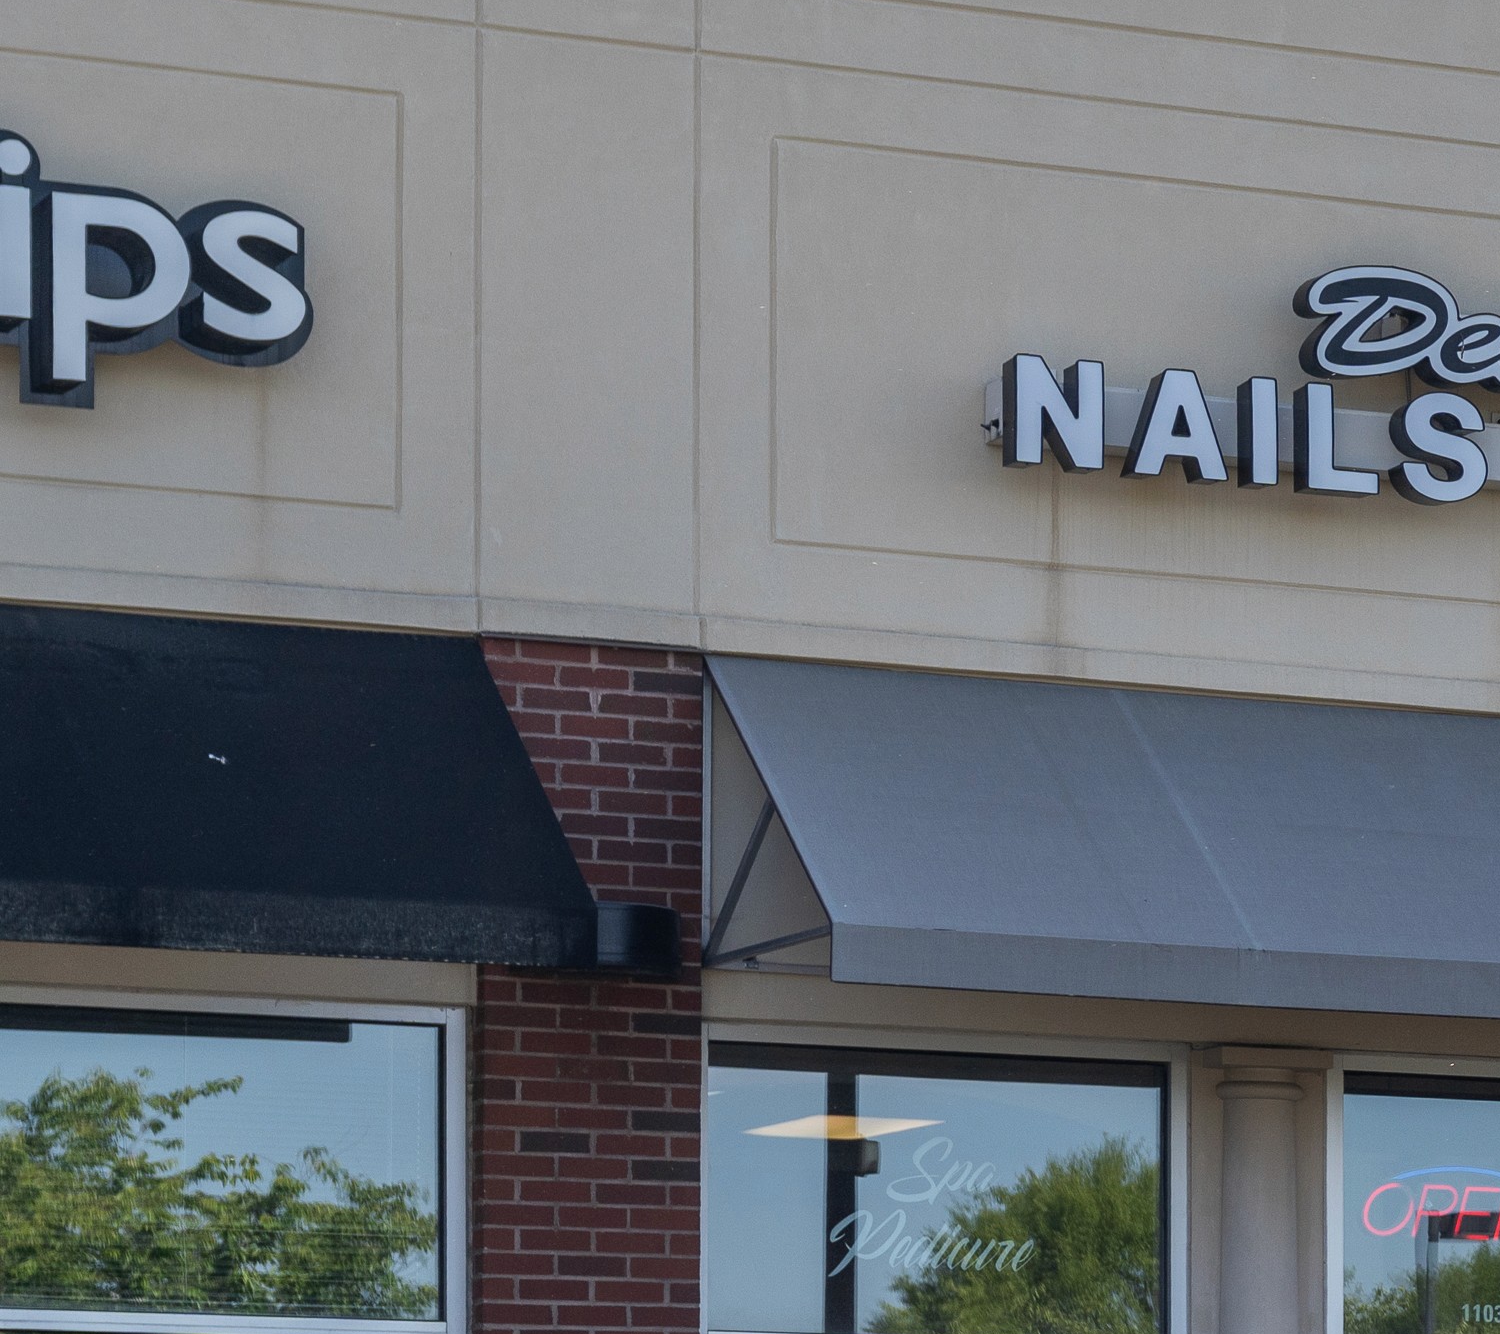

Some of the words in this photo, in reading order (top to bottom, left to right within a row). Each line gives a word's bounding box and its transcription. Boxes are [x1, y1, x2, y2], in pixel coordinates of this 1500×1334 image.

[1002, 353, 1490, 505] NAILS
[886, 1136, 996, 1205] Spa
[827, 1208, 1037, 1278] Pedicure
